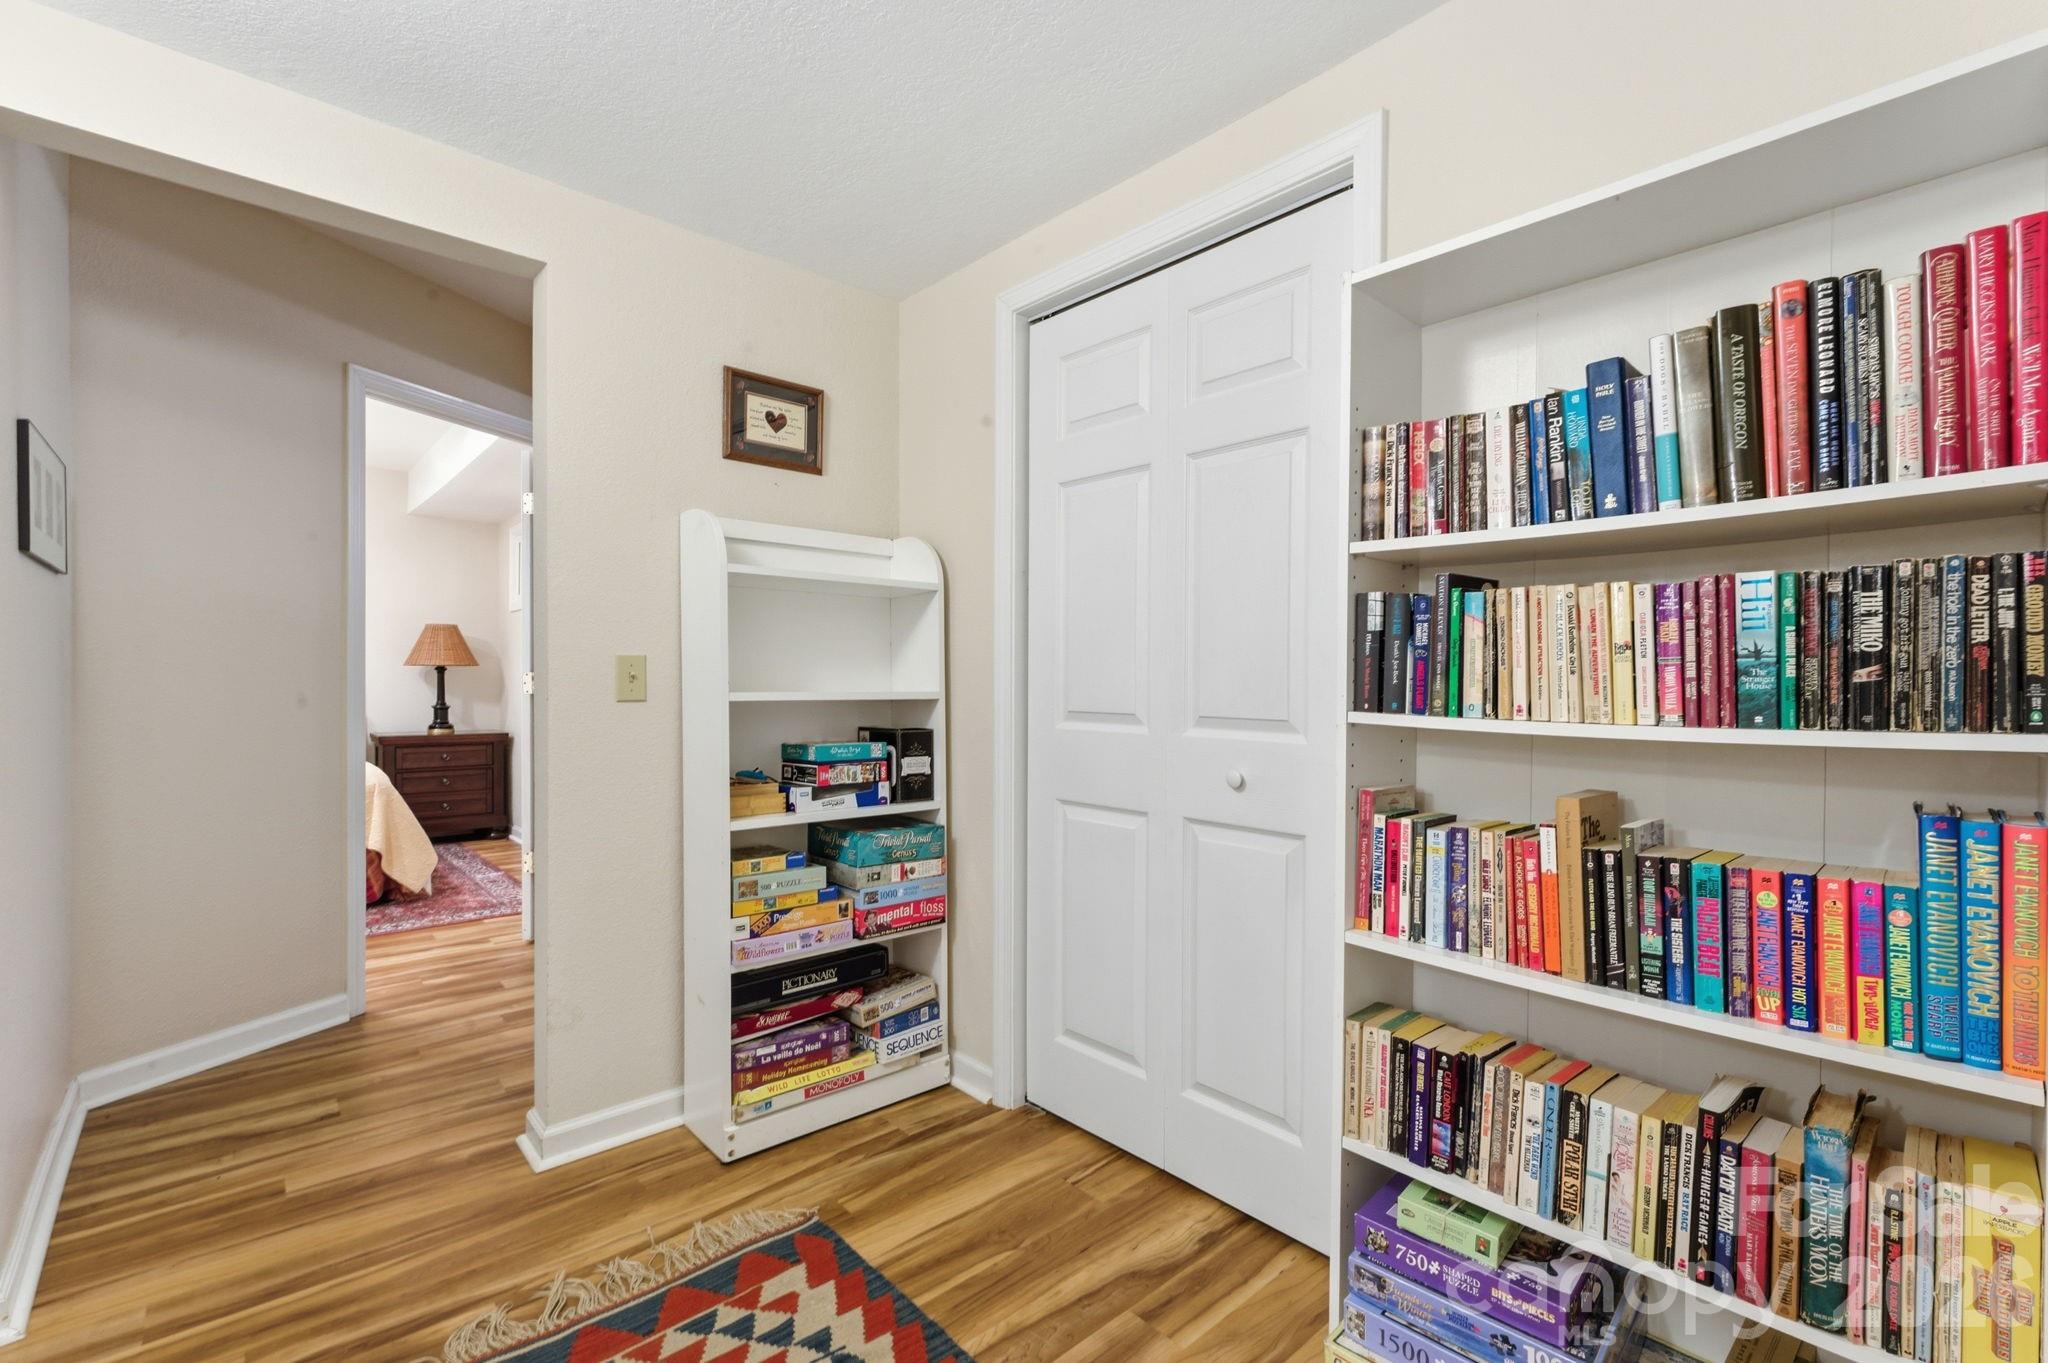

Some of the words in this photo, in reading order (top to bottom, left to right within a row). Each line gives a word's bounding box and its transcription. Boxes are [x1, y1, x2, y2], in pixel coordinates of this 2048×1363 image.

[1978, 235, 1995, 269] MARY
[1931, 252, 1960, 307] CATHERINE
[1816, 282, 1834, 333] ELMORE
[1896, 284, 1913, 330] TOUGH
[1979, 271, 1996, 321] HIGGINS
[1730, 334, 1744, 343] A
[1932, 307, 1960, 354] COULTER
[1980, 323, 1997, 367] CLARK
[1731, 344, 1745, 380] TASTE
[1786, 343, 1799, 379] SEVEN
[1818, 335, 1835, 394] LEONARD
[1898, 333, 1914, 384] COOKIE
[1732, 382, 1746, 397] OF
[1935, 365, 1960, 415] VALENTINE
[1547, 397, 1560, 416] Ian
[1787, 380, 1798, 435] DAUGHTERS
[1907, 407, 1919, 434] DIANE
[1567, 411, 1578, 449] HOWARD
[1576, 415, 1587, 440] LINDA
[1733, 398, 1748, 449] OREGON
[1895, 414, 1906, 458] DAVIDSON
[1934, 414, 1959, 448] LEGACY
[1413, 430, 1424, 466] REFLEX
[1548, 416, 1563, 463] Rankin
[1909, 436, 1919, 462] MOTT
[1789, 450, 1801, 471] EVE
[1581, 479, 1591, 496] TO
[1582, 496, 1592, 515] DIE
[1947, 572, 1961, 591] the
[1971, 574, 1990, 604] DEAD
[1740, 577, 1773, 631] Hill
[1861, 589, 1884, 614] THE
[1947, 592, 1961, 615] hole
[2025, 584, 2045, 632] GROUND
[1590, 609, 1598, 634] CONAN
[1861, 614, 1884, 653] MIKO
[1946, 626, 1960, 644] the
[1947, 616, 1960, 625] in
[1971, 606, 1989, 644] LETTER
[1946, 646, 1960, 669] zero
[2026, 634, 2045, 677] MONEY
[1592, 650, 1600, 696] ADVENTURER
[1741, 674, 1776, 685] Stranger
[1745, 681, 1772, 692] House
[1752, 667, 1767, 678] The
[873, 834, 903, 850] Trivial
[1373, 827, 1385, 872] MARATHON
[1926, 832, 1958, 887] JANET
[1966, 839, 2000, 905] JANET
[2013, 839, 2040, 882] JANET
[776, 879, 802, 889] PUZZLE
[880, 889, 898, 900] 1000
[1374, 872, 1384, 892] MAN
[1517, 889, 1524, 898] OF
[1643, 877, 1654, 892] TONY
[877, 902, 944, 925] mental_floss
[1517, 900, 1525, 919] GODS
[1528, 883, 1537, 914] GREGORY
[1643, 892, 1656, 928] HILLERMAN
[1530, 914, 1539, 952] MCDONALD
[1671, 917, 1684, 932] THE
[1696, 896, 1721, 943] PACIFIC
[1757, 906, 1779, 936] JANET
[1791, 912, 1806, 939] JANET
[1823, 913, 1844, 943] JANET
[2013, 884, 2040, 960] EVANOVICH
[743, 946, 785, 961] Wildflowers
[1609, 928, 1618, 965] FREEMANTLE
[1672, 932, 1684, 964] SISTERS
[1889, 925, 1909, 953] JANET
[1926, 890, 1959, 987] EVANOVICH
[1697, 943, 1721, 979] BEAT
[1757, 936, 1779, 987] EVANOVICH
[1791, 939, 1807, 986] EVANOVICH
[1824, 943, 1846, 993] EVANOVICH
[1891, 953, 1912, 999] EVANOVICH
[1966, 905, 1999, 1018] EVANOVICH
[782, 967, 838, 990] PICTIONARY
[2013, 965, 2040, 990] TO
[880, 1002, 894, 1013] 500
[1757, 995, 1781, 1012] UP
[1792, 987, 1807, 1005] HOT
[2013, 990, 2040, 1022] THE
[1793, 1005, 1807, 1020] SIX
[1890, 1000, 1903, 1041] MONEY
[1927, 994, 1943, 1038] SHARP
[1945, 995, 1960, 1042] TWELVE
[1968, 1017, 2000, 1030] TEN
[886, 1024, 943, 1057] SEQUENCE
[1968, 1029, 2000, 1044] BIG
[760, 1055, 772, 1065] La
[791, 1047, 804, 1057] de
[805, 1042, 822, 1055] Noël
[761, 1069, 786, 1082] Holiday
[787, 1057, 829, 1073] Homecoming
[768, 1081, 789, 1093] WILD
[794, 1075, 811, 1086] LIFE
[817, 1066, 842, 1079] LOTTO
[809, 1072, 861, 1096] MONOPOLY
[1444, 1070, 1452, 1089] CAIT
[1364, 1096, 1375, 1119] STICK
[1443, 1089, 1452, 1122] LONDON
[1512, 1088, 1521, 1103] Dick
[1510, 1105, 1520, 1130] Francis
[1702, 1113, 1714, 1139] COLLINS
[1684, 1132, 1694, 1154] DICK
[1564, 1141, 1582, 1179] POLAR
[1683, 1154, 1693, 1190] FRANCIS
[1720, 1156, 1736, 1176] DAY
[1562, 1180, 1580, 1212] STAR
[1701, 1168, 1711, 1206] HUNGER
[1720, 1177, 1736, 1189] OF
[1682, 1192, 1691, 1209] RAT
[1719, 1190, 1735, 1234] WRATH
[1829, 1187, 1844, 1210] THE
[1681, 1209, 1689, 1233] RACE
[1699, 1212, 1708, 1245] GAMES
[1829, 1212, 1844, 1238] TIME
[1991, 1216, 2017, 1229] APPLE
[1394, 1242, 1429, 1272] 750
[1809, 1242, 1828, 1288] MOON
[1829, 1244, 1843, 1259] OF
[1442, 1264, 1481, 1289] SHAPED
[1442, 1273, 1480, 1297] PUZZLE
[1829, 1261, 1843, 1282] THE
[1490, 1286, 1515, 1305] BITS
[1521, 1302, 1557, 1324] PIECES
[2015, 1291, 2035, 1327] THE
[1379, 1327, 1430, 1363] 1500
